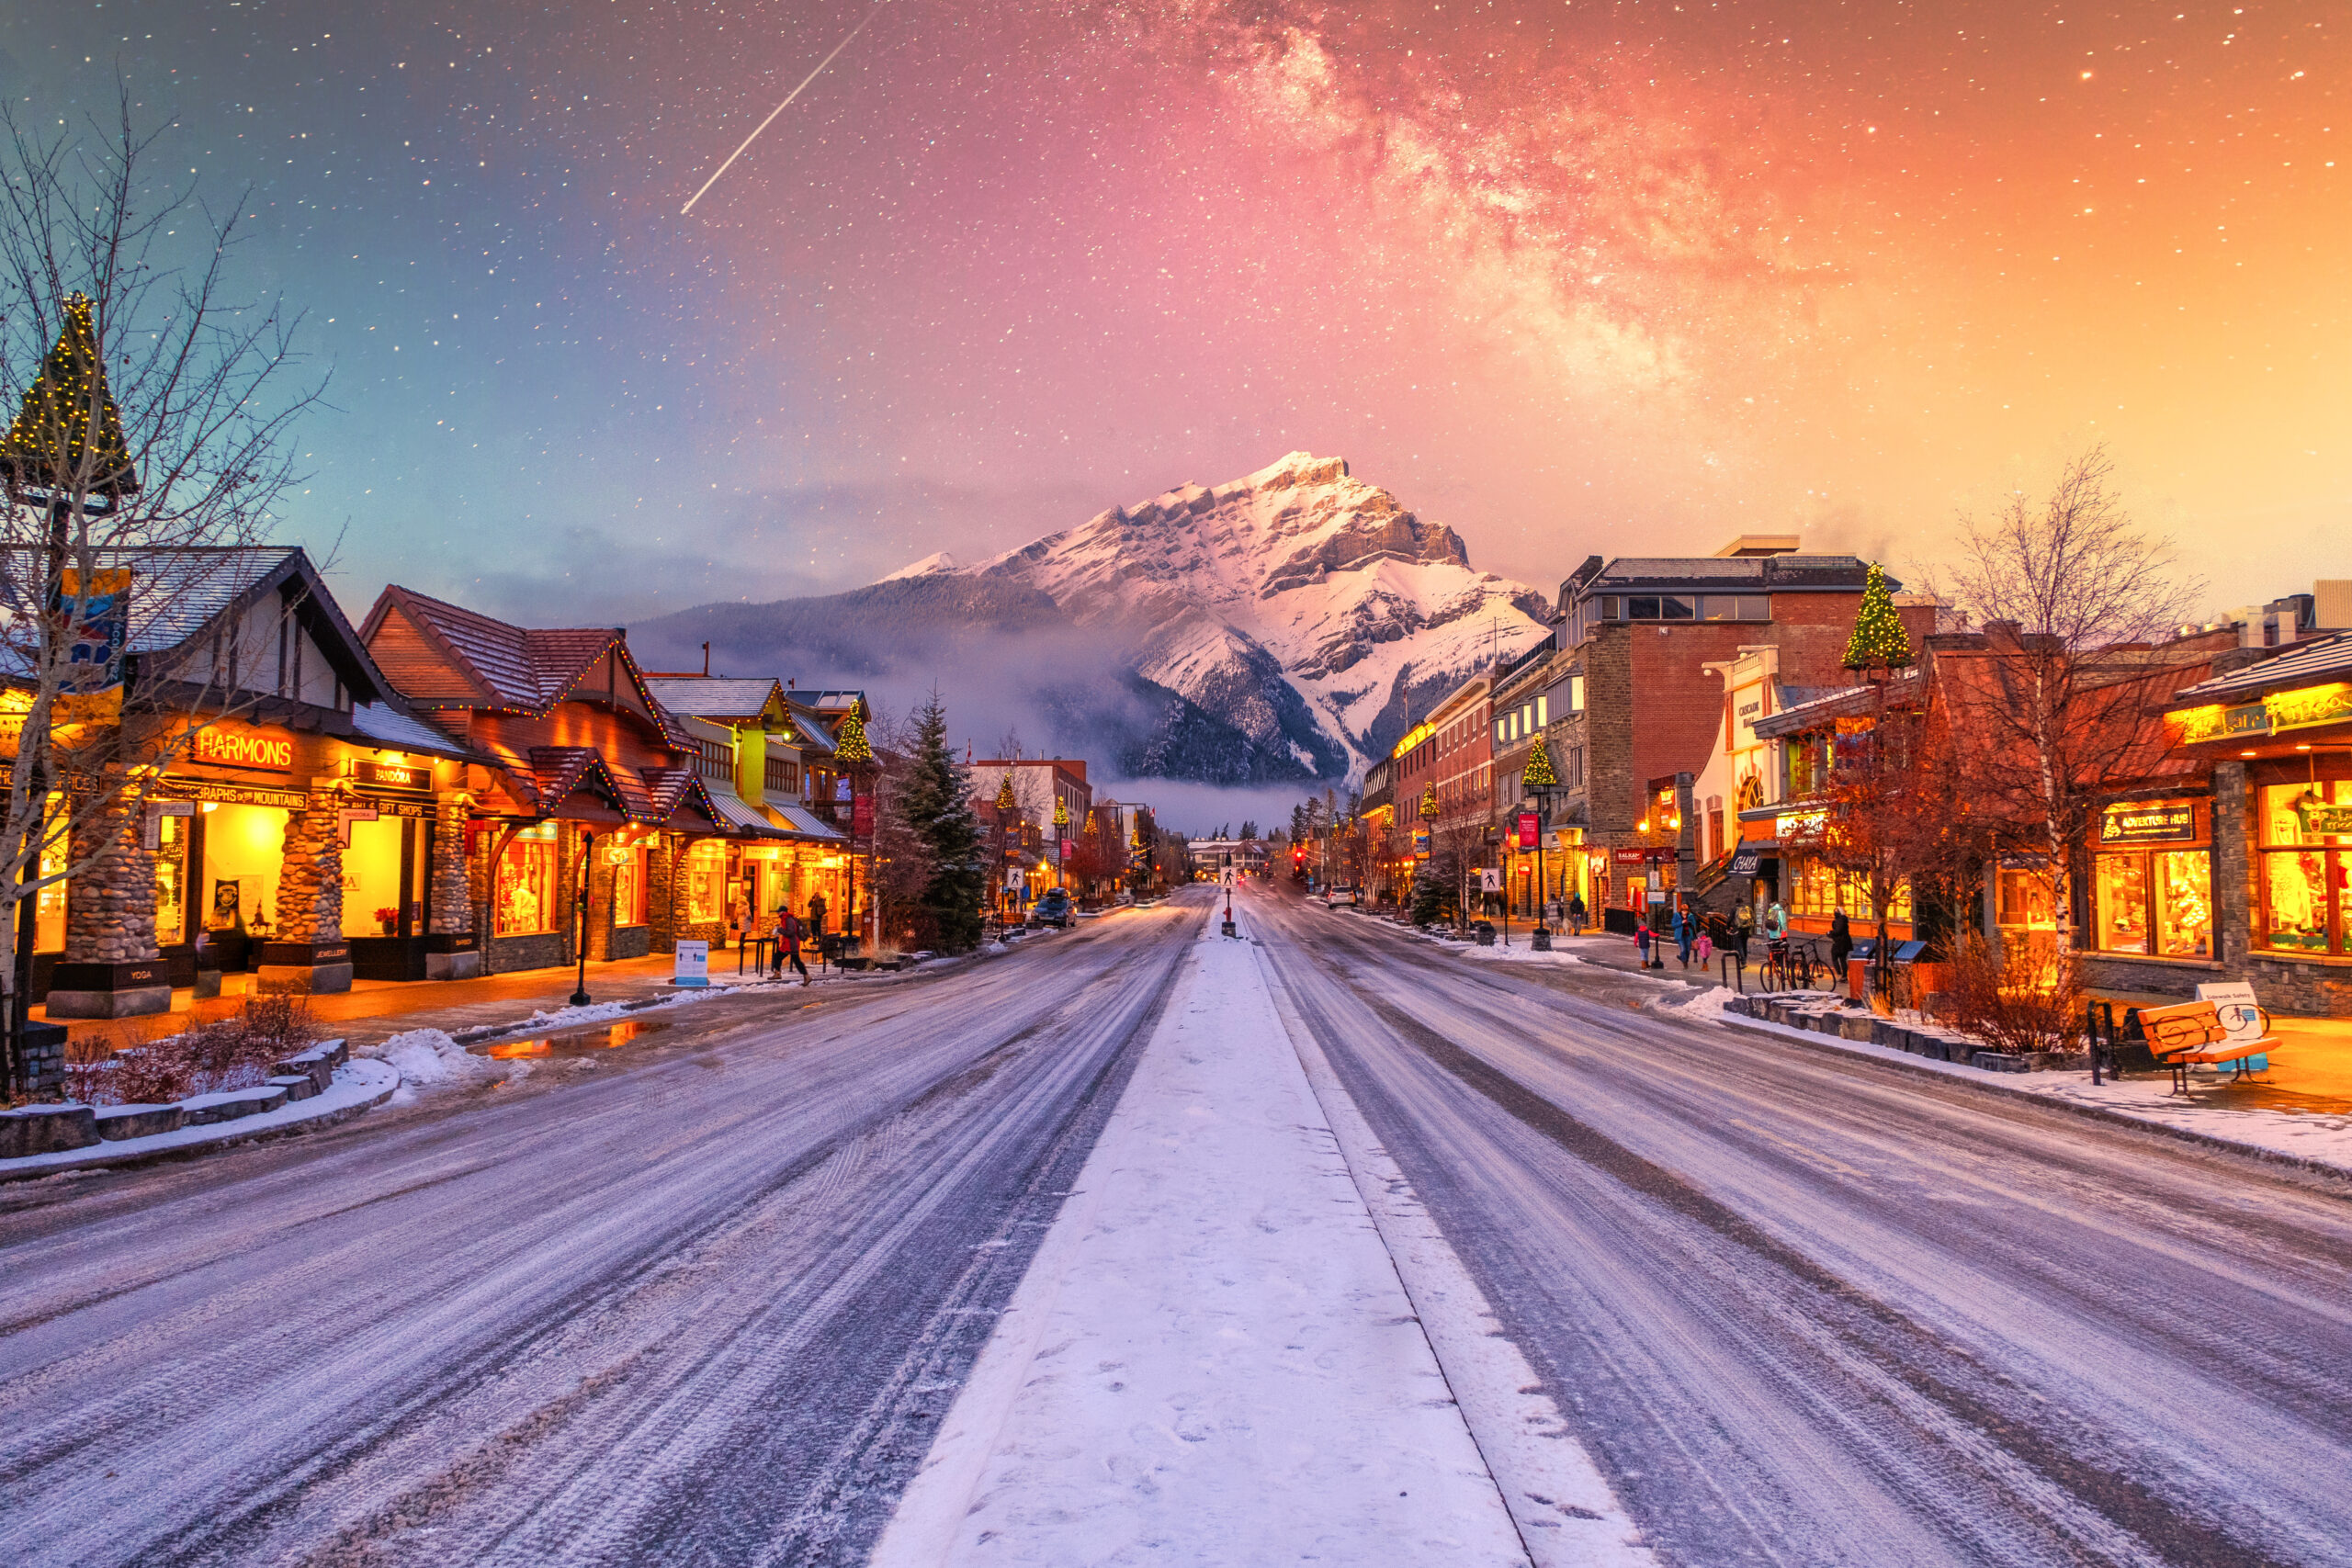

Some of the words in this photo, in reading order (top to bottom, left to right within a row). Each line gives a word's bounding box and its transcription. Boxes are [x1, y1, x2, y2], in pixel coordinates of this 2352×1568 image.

[1739, 701, 1759, 716] CASCADE
[199, 731, 291, 766] HARMONS
[254, 792, 305, 807] MOUNTAINS
[379, 802, 395, 814] GIFT
[399, 805, 423, 817] SHOPS
[2122, 815, 2169, 828] ADVENTURE
[2170, 813, 2188, 824] HUB
[1734, 855, 1758, 870] CHAYA
[316, 949, 347, 958] JEWELLERY
[131, 970, 152, 979] YOGA
